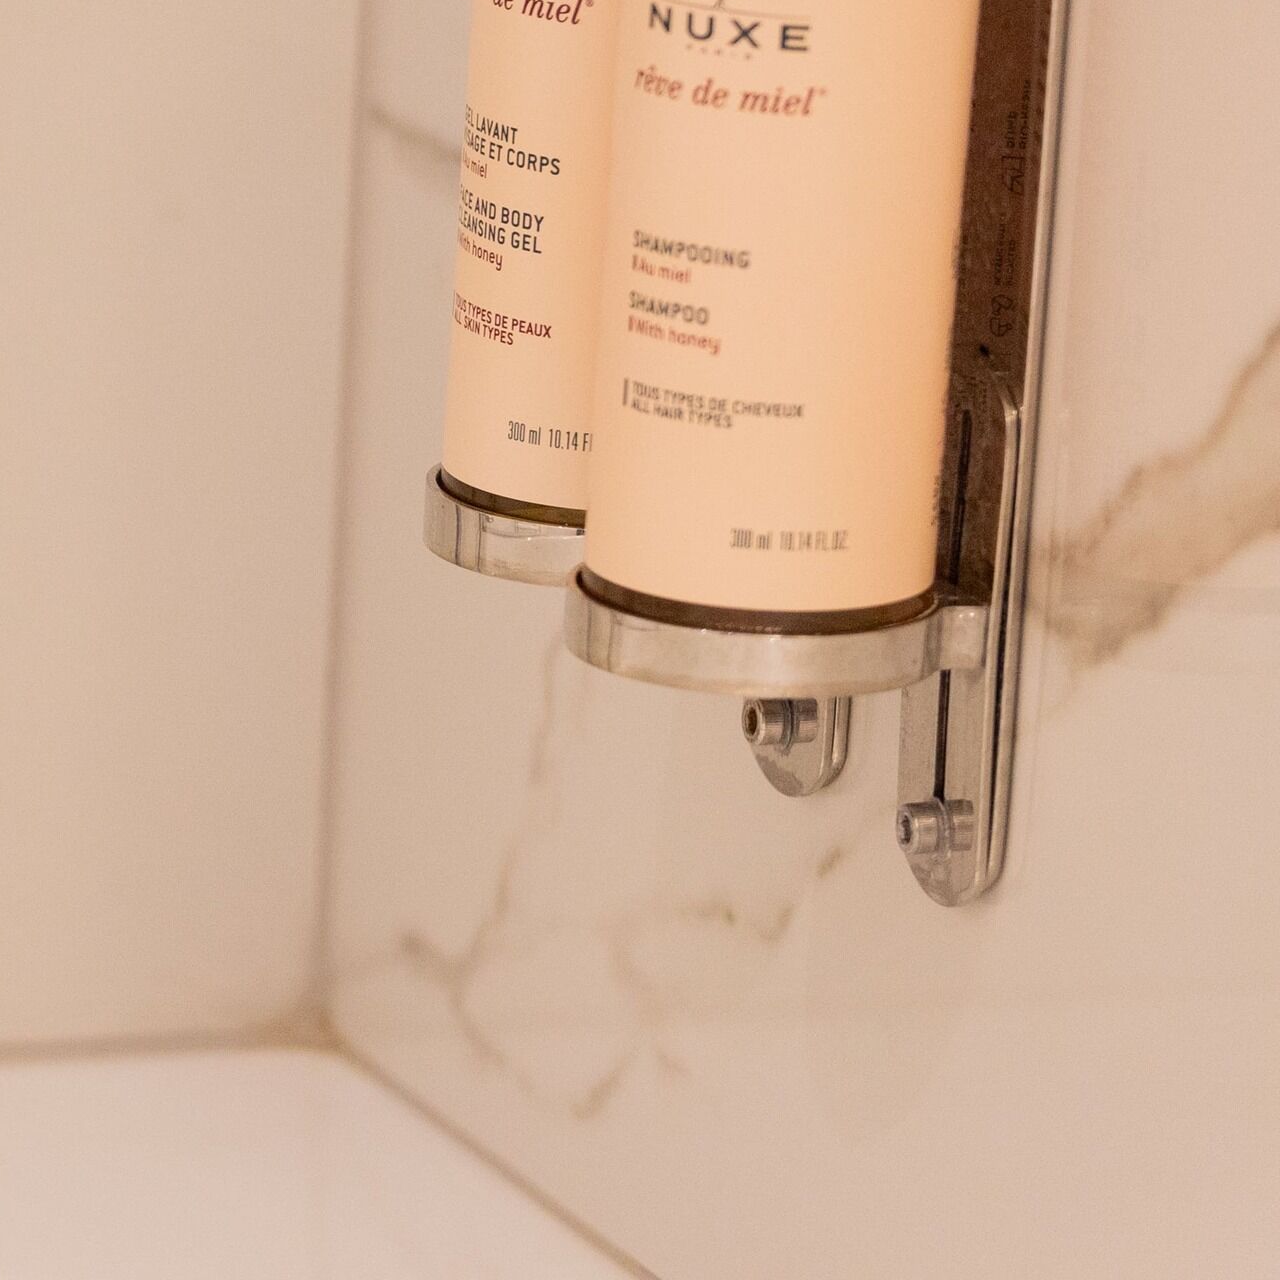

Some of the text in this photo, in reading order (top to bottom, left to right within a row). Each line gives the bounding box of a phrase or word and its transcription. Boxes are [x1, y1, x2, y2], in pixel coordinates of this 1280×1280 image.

[648, 2, 811, 52] NUXE
[634, 64, 683, 100] rêve
[691, 78, 729, 109] de
[476, 113, 518, 145] LAVANT
[471, 160, 488, 179] miel
[489, 142, 503, 162] ET
[507, 148, 561, 176] CORPS
[474, 197, 497, 220] AND
[501, 207, 545, 233] BODY
[472, 240, 503, 271] honey
[511, 231, 543, 254] GEL
[632, 229, 751, 269] SHAMPOOING
[658, 266, 691, 283] miel
[468, 302, 492, 324] TYPES
[495, 313, 508, 330] DE
[511, 318, 552, 339] PEAUX
[628, 290, 710, 326] SHAMPOO
[464, 315, 481, 336] SKIN
[483, 324, 514, 346] TYPES
[668, 326, 721, 356] honey
[663, 389, 705, 410] TYPES
[507, 420, 526, 443] 300
[528, 426, 542, 446] ml
[549, 428, 578, 451] 10.14
